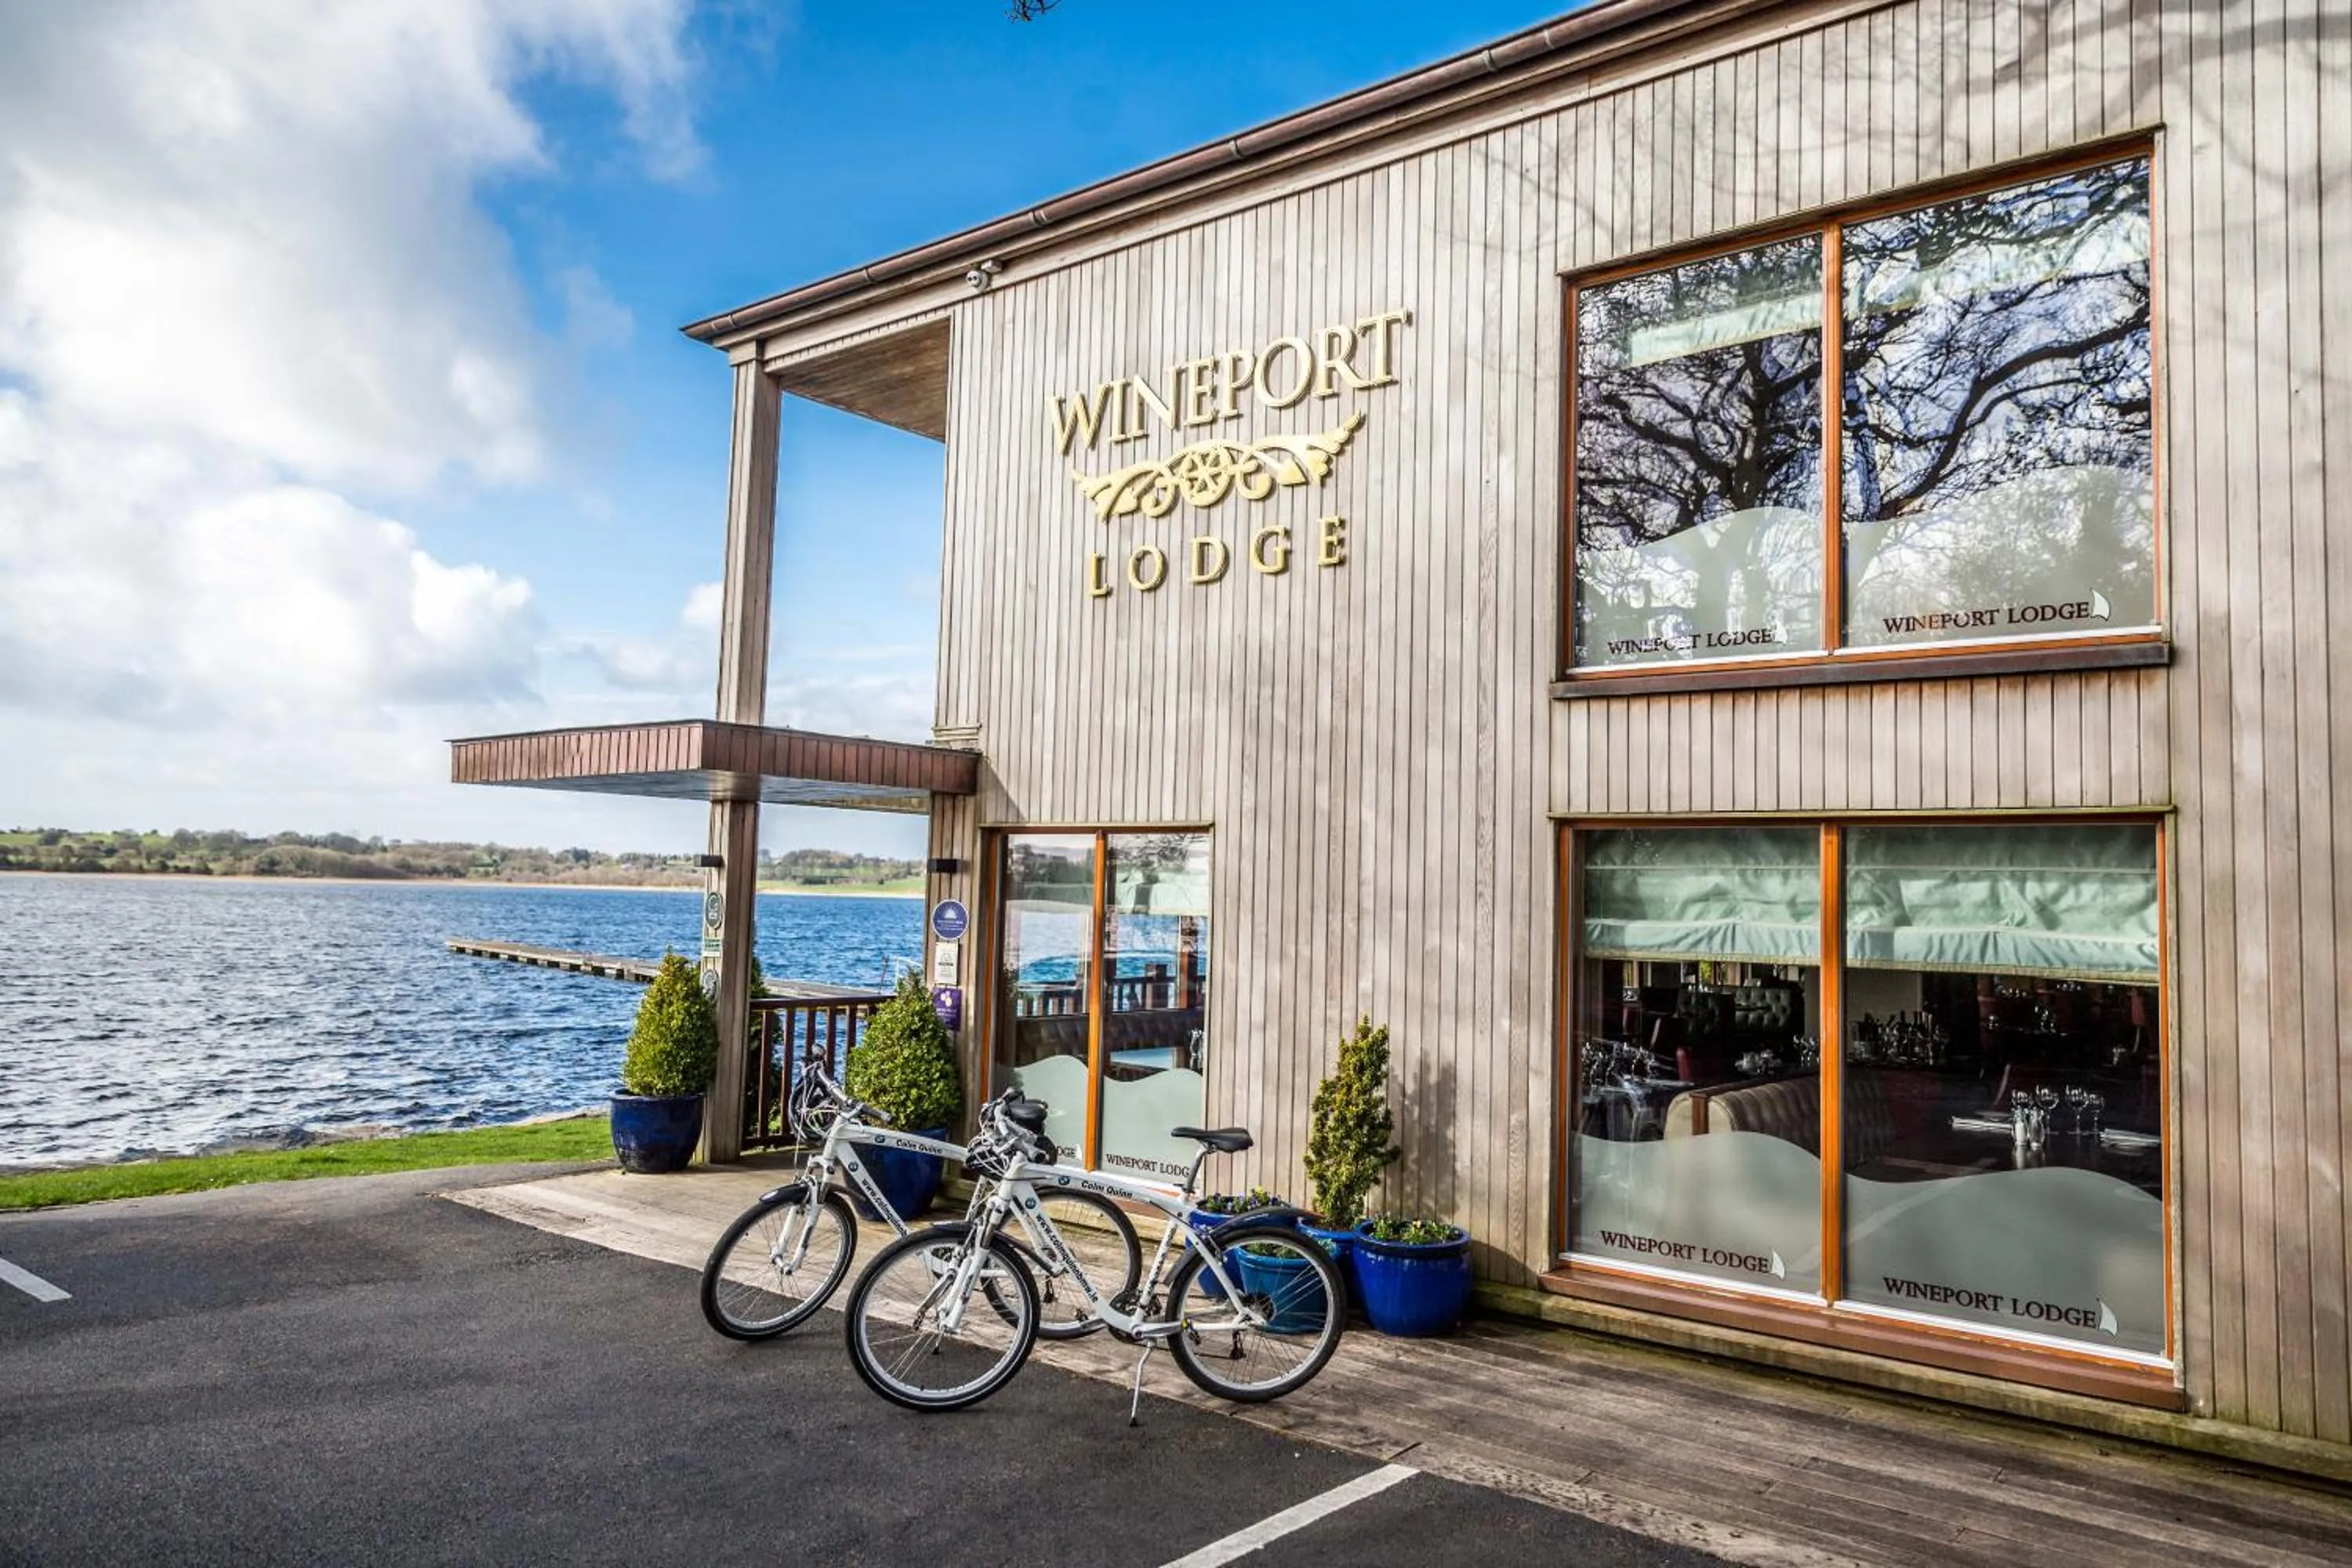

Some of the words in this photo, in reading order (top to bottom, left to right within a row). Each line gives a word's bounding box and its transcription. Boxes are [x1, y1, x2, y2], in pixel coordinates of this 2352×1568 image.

[1047, 307, 1412, 455] WINEPORT
[1089, 515, 1345, 596] LODGE
[1882, 609, 1999, 633] WINEPORT
[2007, 602, 2090, 623] LODGE
[1608, 634, 1700, 655] WINEPOT
[1706, 628, 1773, 648] LODGE
[1056, 1145, 1076, 1158] DGE
[1105, 1153, 1158, 1171] WINEPORT
[1160, 1163, 1190, 1177] LODG
[862, 1178, 907, 1236] www.colmquinnb
[1081, 1180, 1104, 1192] Colm
[1106, 1186, 1133, 1199] Quinn
[1601, 1230, 1696, 1260] WINEPORT
[1702, 1247, 1771, 1274] LODGE
[1883, 1277, 2003, 1312] WINEPORT
[2012, 1298, 2096, 1328] LODGE
